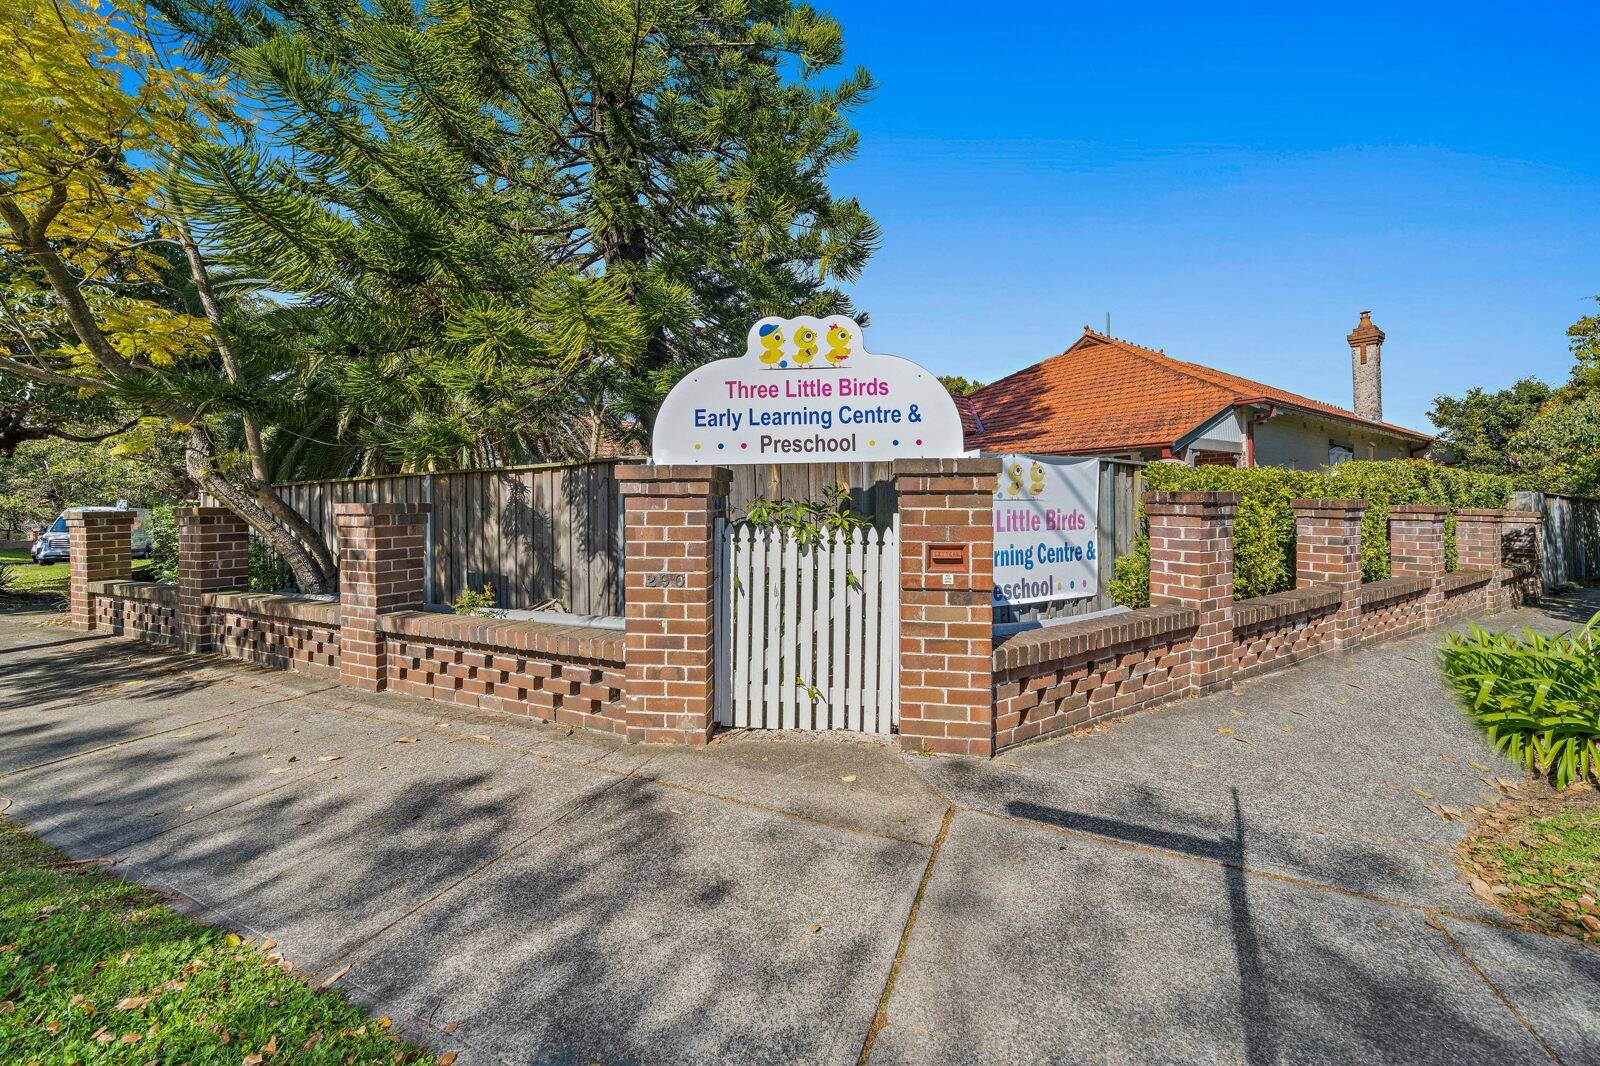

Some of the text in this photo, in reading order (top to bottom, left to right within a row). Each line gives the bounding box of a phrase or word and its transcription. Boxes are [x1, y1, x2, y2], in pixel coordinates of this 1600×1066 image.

[725, 378, 889, 399] Three Little Birds
[694, 404, 922, 432] Early Learning Centre &
[760, 433, 857, 453] Preschool
[996, 508, 1086, 533] Little Birds
[994, 540, 1096, 570] rning Centre &
[993, 575, 1054, 601] eschool
